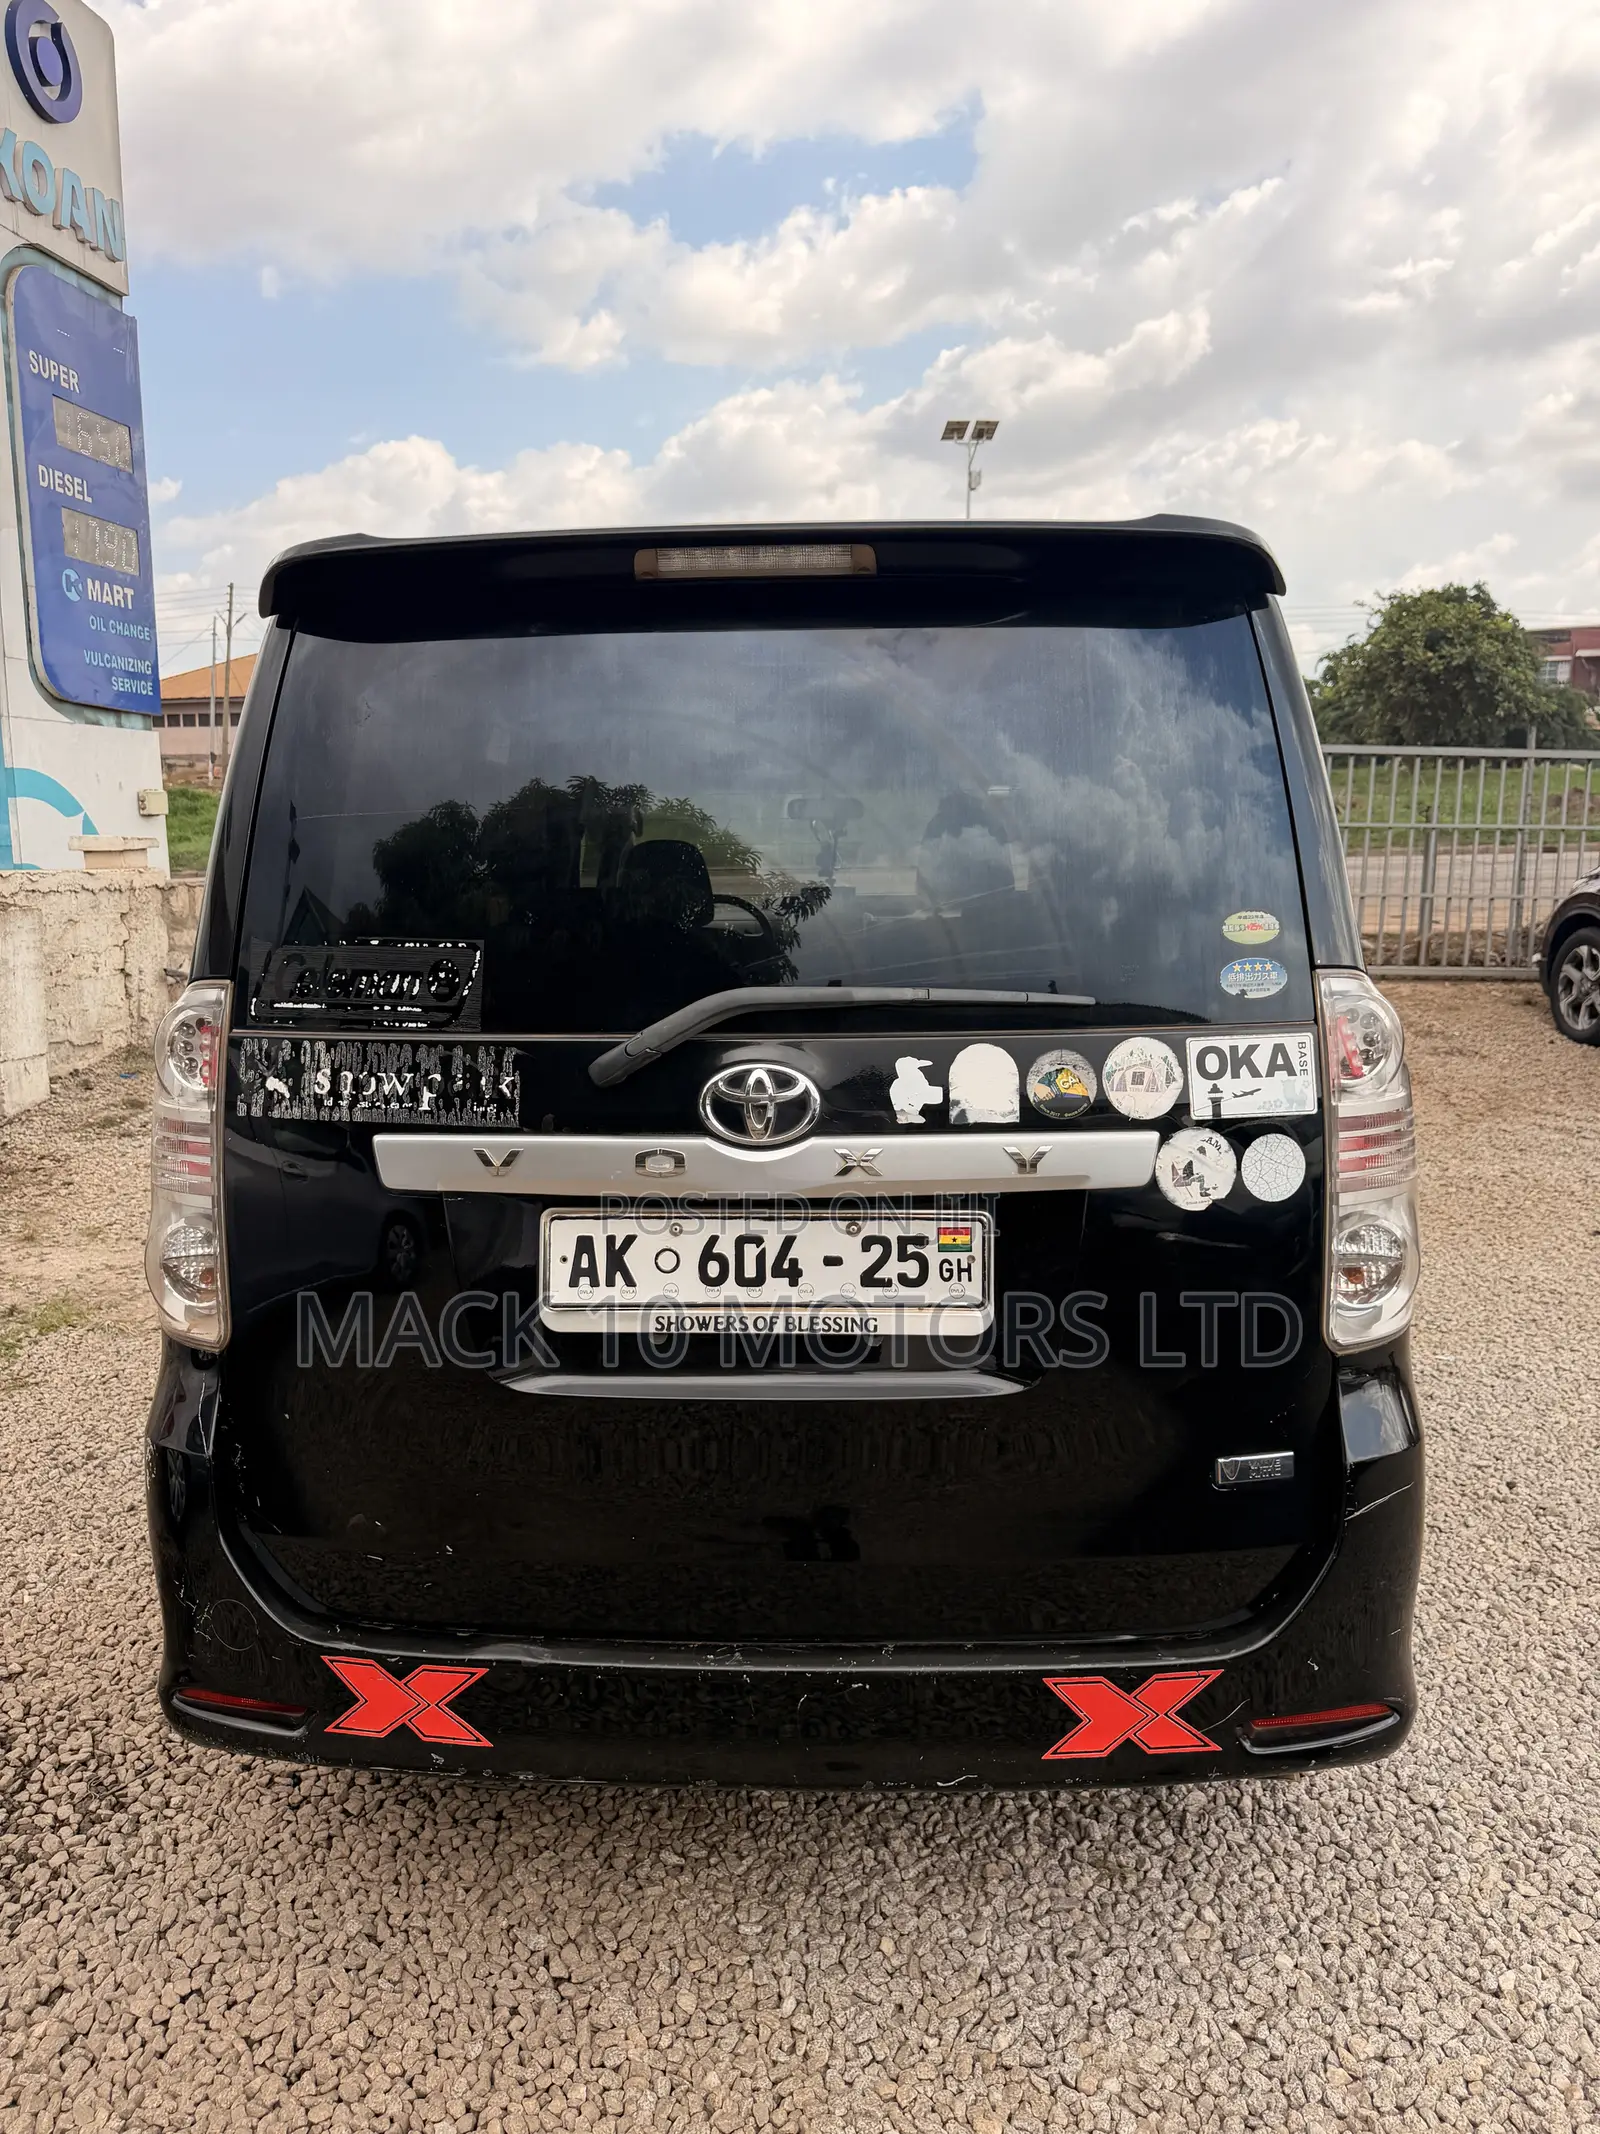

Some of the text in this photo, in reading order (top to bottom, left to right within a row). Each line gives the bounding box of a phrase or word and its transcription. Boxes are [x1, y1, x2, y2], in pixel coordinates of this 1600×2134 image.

[29, 350, 80, 393] SUPER
[38, 464, 92, 503] DIESEL
[86, 577, 135, 609] MART
[89, 615, 151, 641] OIL CHANGE
[84, 650, 152, 675] VULCANIZING
[111, 676, 154, 696] SERVICE
[1196, 1043, 1297, 1080] OKA
[1297, 1041, 1308, 1076] BASE
[568, 1234, 638, 1288] AK
[698, 1233, 803, 1288] 604
[859, 1234, 930, 1288] 25
[938, 1258, 972, 1283] GH
[654, 1315, 878, 1334] SHOWERS OF BLESSING
